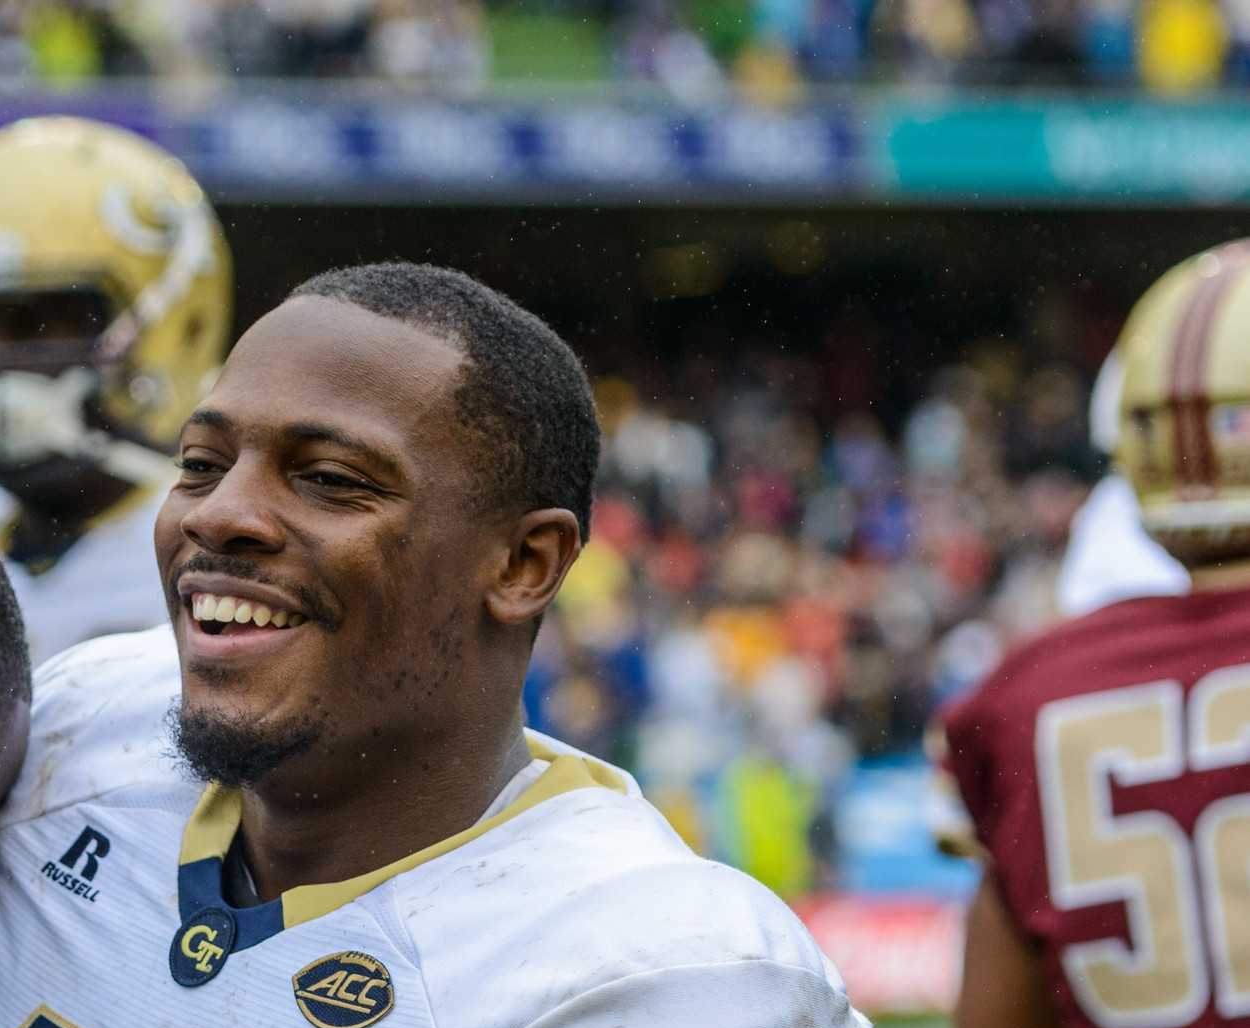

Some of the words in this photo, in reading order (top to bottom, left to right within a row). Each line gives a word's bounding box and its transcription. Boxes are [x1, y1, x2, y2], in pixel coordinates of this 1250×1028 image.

[41, 861, 102, 903] RUSSELL
[181, 924, 225, 972] GT
[310, 970, 387, 1006] ACC
